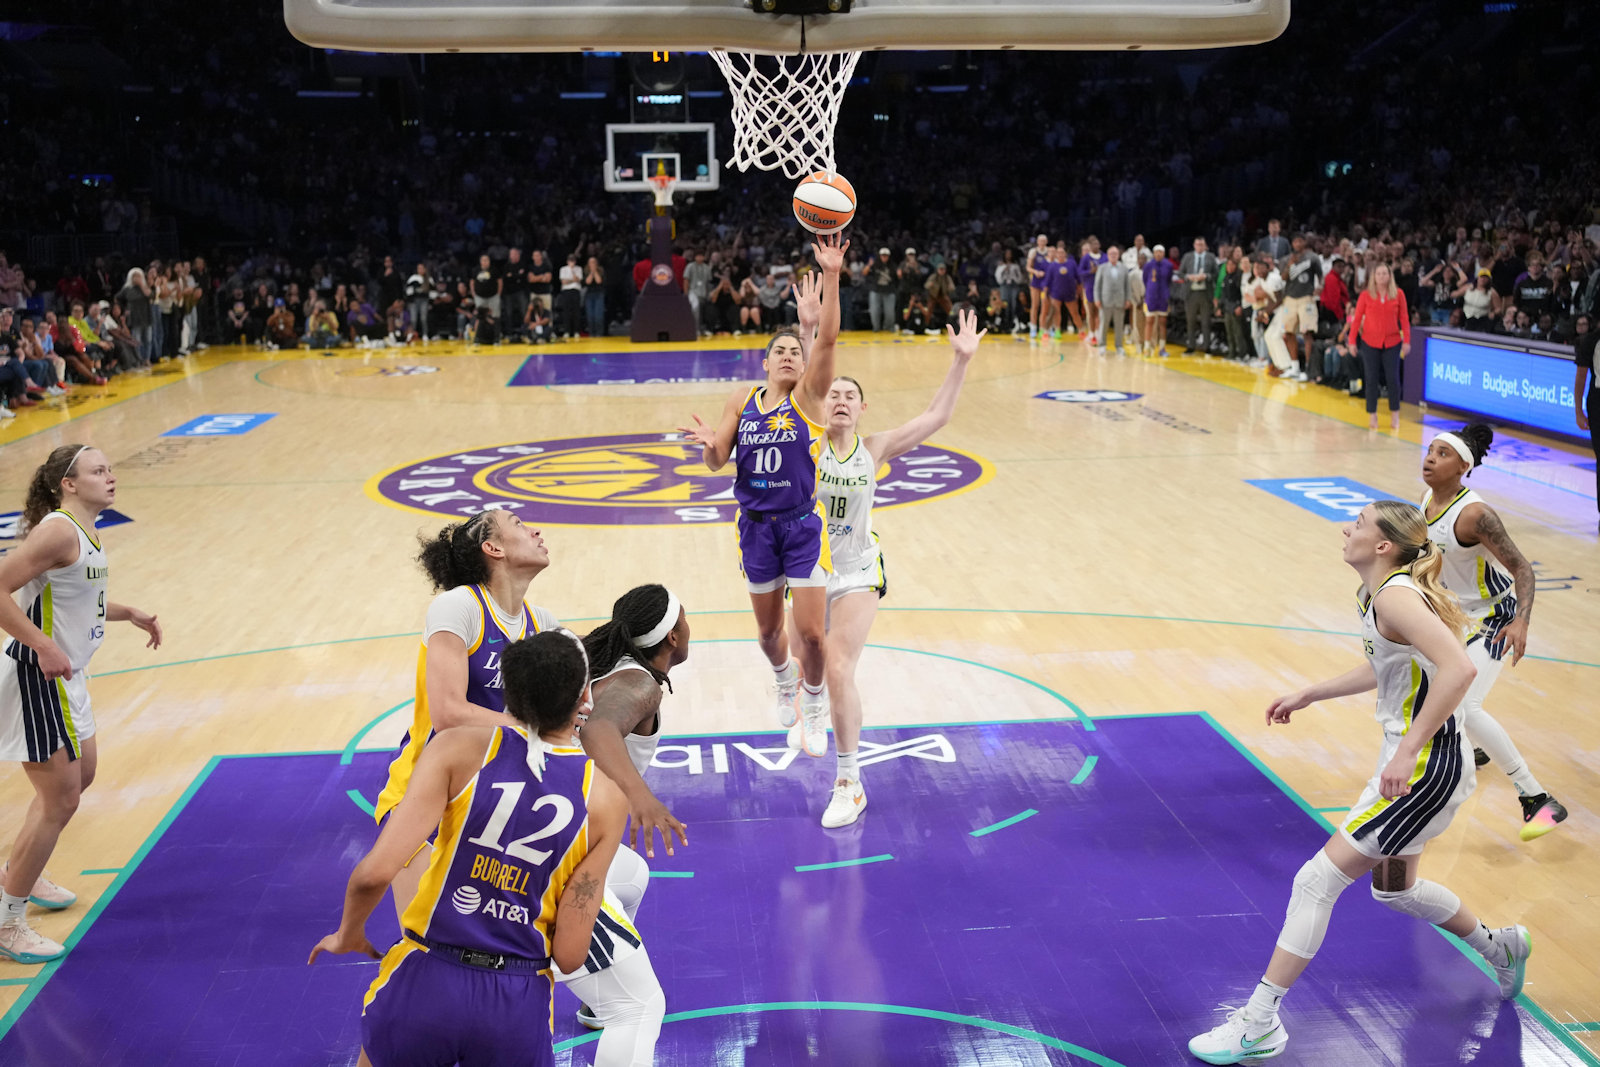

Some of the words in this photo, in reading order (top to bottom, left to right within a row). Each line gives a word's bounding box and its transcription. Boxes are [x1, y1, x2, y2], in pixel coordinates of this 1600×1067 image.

[799, 206, 837, 226] Wilson
[1444, 364, 1472, 386] Albert
[1482, 371, 1519, 398] Budget.
[1521, 379, 1558, 404] Spend.
[738, 419, 760, 432] LOS
[740, 430, 798, 445] ANGELES
[752, 446, 783, 474] 10
[768, 480, 792, 489] Health
[830, 496, 847, 519] 18
[97, 590, 105, 617] 9
[650, 742, 801, 775] Alb
[468, 781, 574, 866] 12
[470, 854, 530, 896] BURRELL
[482, 898, 529, 925] AT&T
